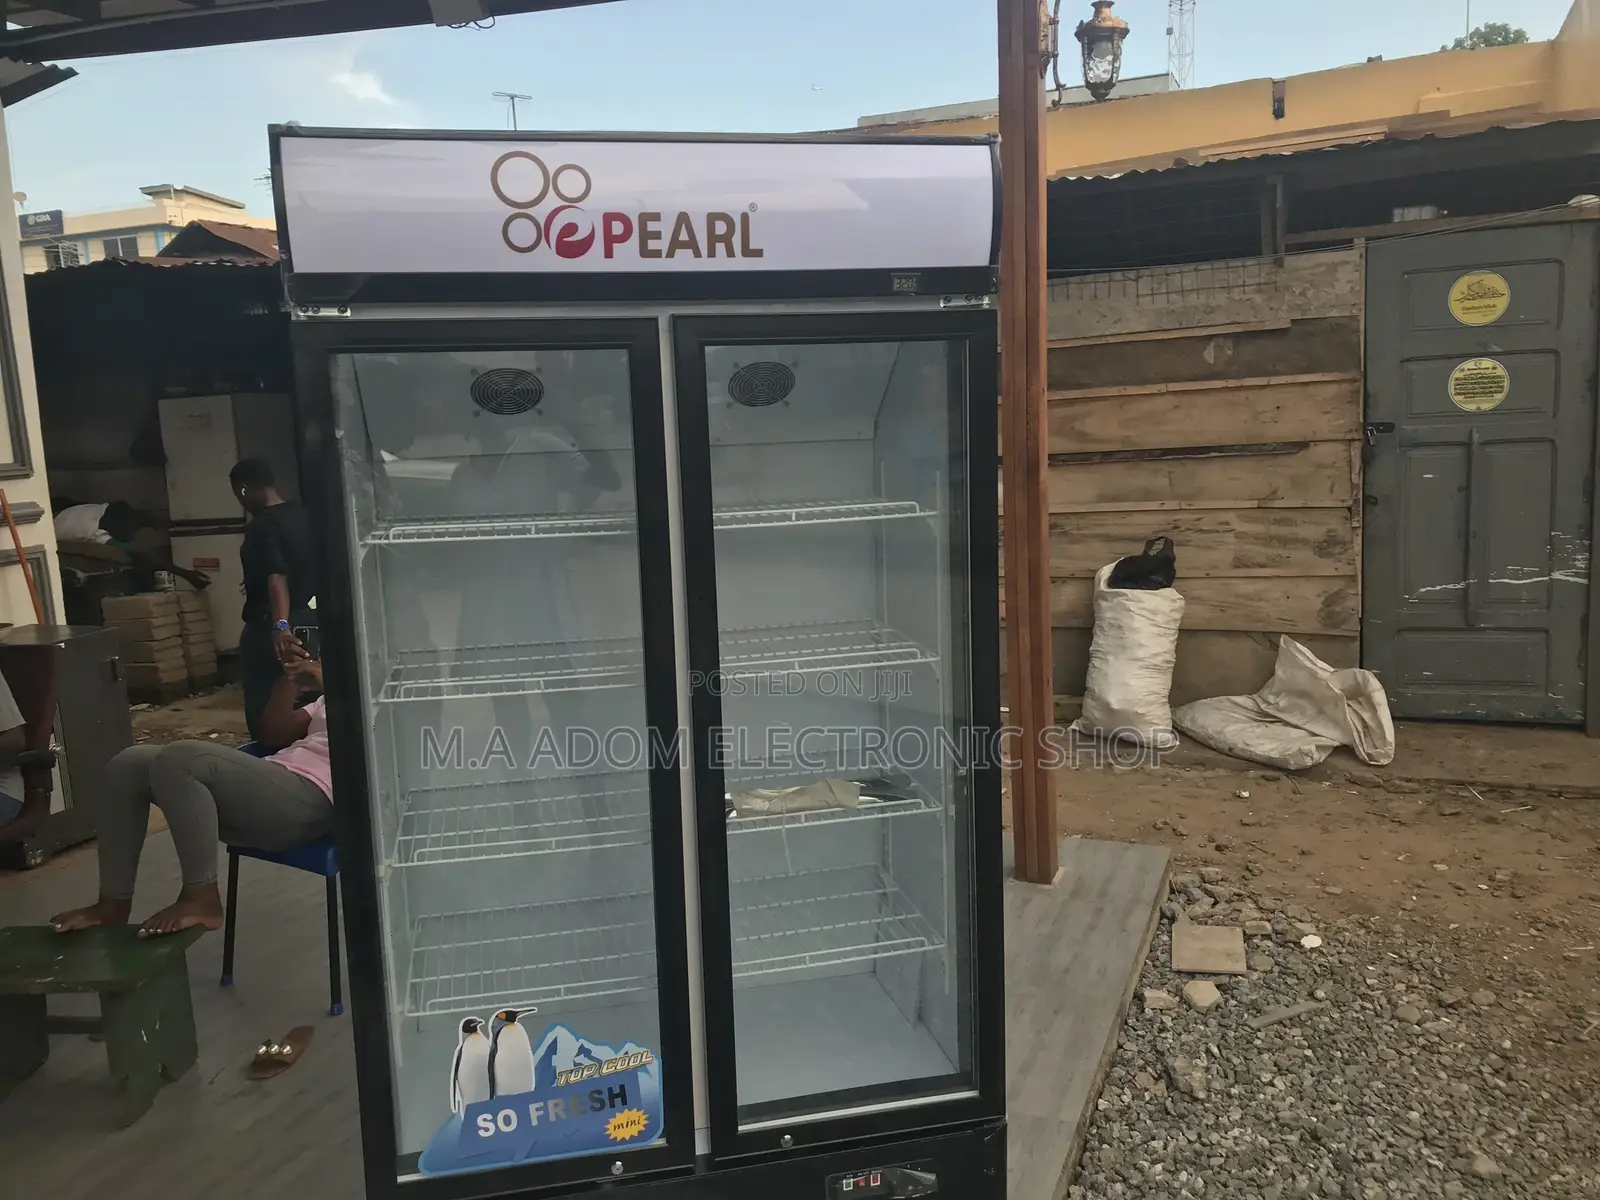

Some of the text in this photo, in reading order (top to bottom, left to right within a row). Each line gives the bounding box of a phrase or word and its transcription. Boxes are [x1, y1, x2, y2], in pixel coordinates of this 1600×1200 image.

[602, 211, 764, 259] PEARL
[557, 1050, 655, 1086] TOP COOL
[476, 1084, 628, 1138] SO FRESH
[613, 1115, 642, 1132] mini
